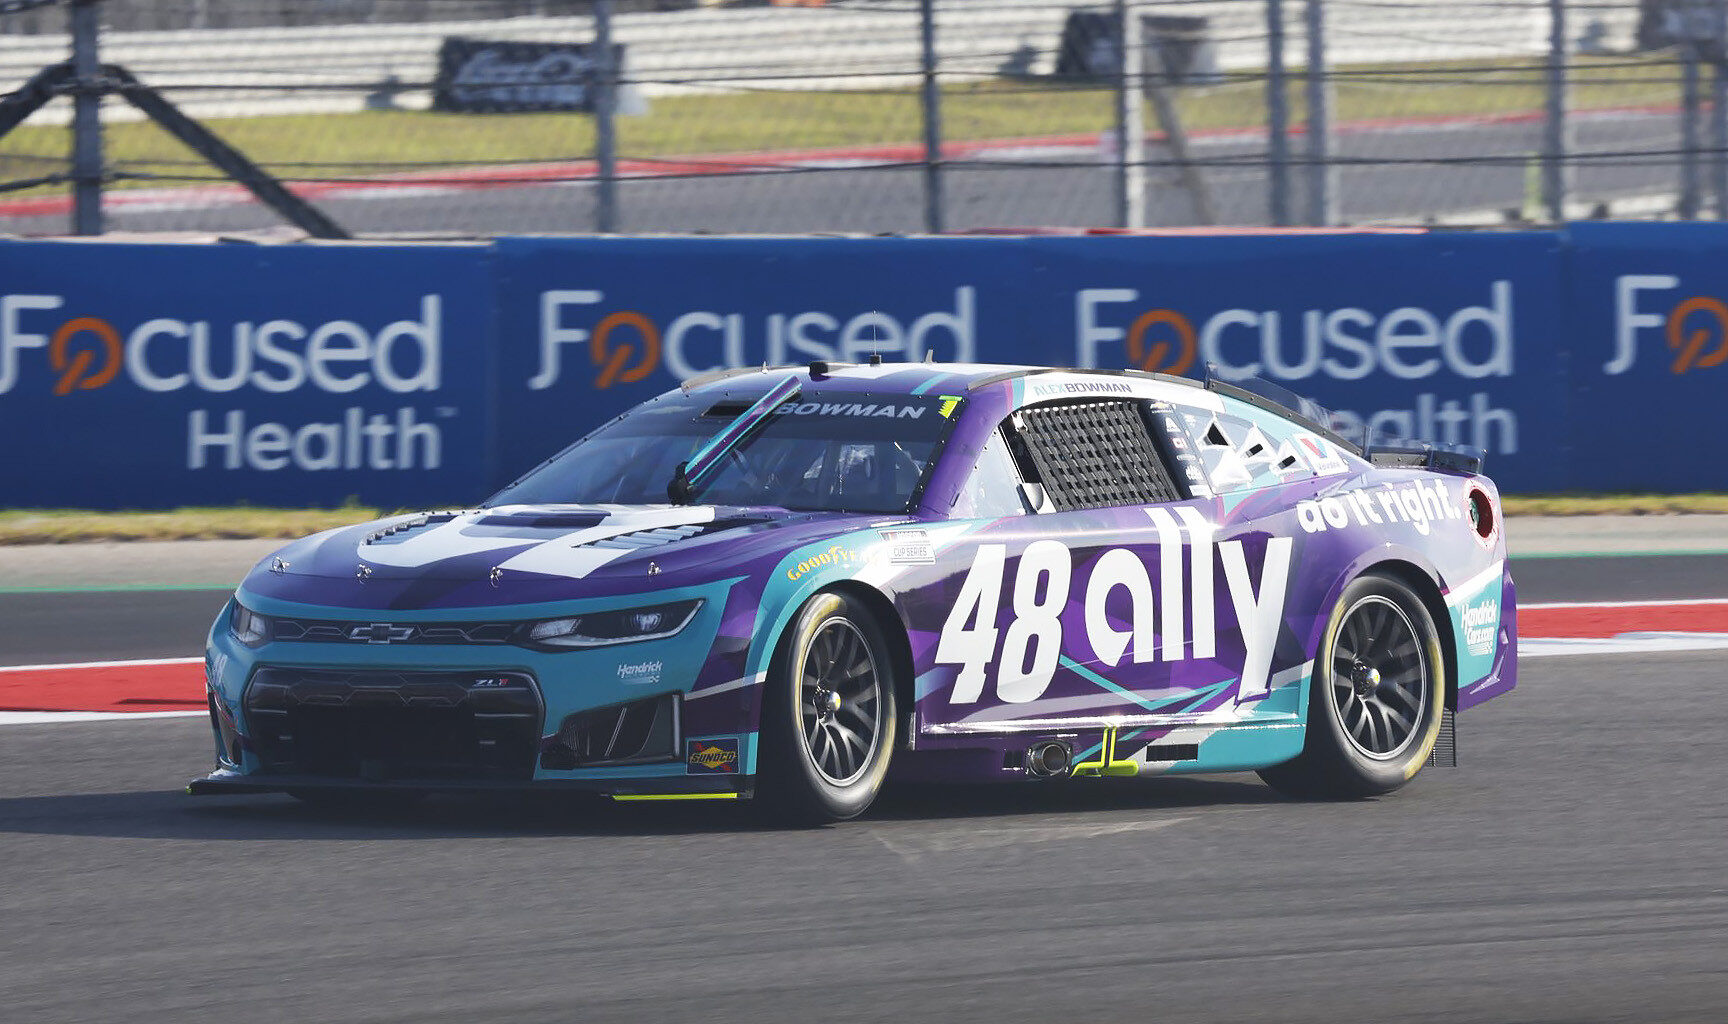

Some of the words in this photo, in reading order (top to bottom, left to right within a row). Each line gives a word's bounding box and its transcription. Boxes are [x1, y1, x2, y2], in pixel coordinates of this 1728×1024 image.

[0, 294, 442, 395] Focused
[528, 285, 976, 391] Focused
[1076, 279, 1514, 380] Focused
[187, 407, 441, 471] Health
[774, 402, 926, 419] BOWMAN
[1304, 392, 1518, 455] ealth
[934, 539, 1073, 705] 48
[1085, 505, 1293, 701] ally
[617, 660, 663, 679] Hendrick
[690, 750, 738, 765] SUNOCO
